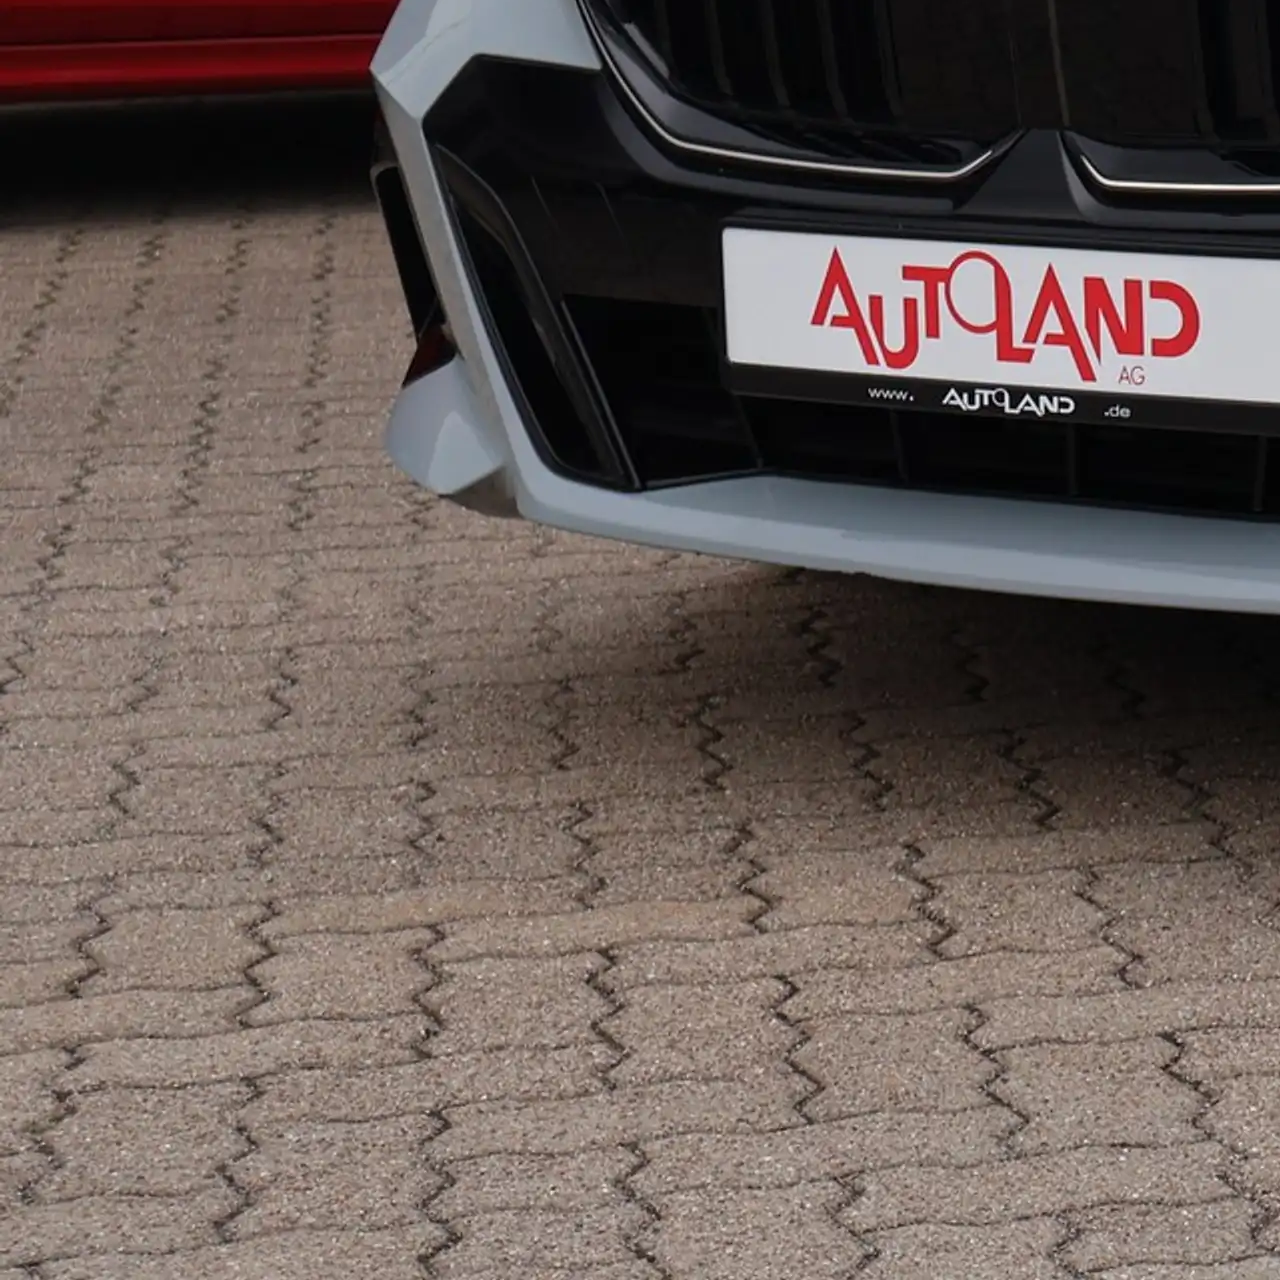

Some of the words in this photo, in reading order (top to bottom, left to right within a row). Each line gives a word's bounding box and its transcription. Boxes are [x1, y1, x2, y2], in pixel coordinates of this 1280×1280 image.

[810, 246, 1202, 384] AUTOLAND
[1117, 365, 1147, 387] AG
[941, 387, 1076, 417] AUTOLAND
[1103, 403, 1132, 419] .de
